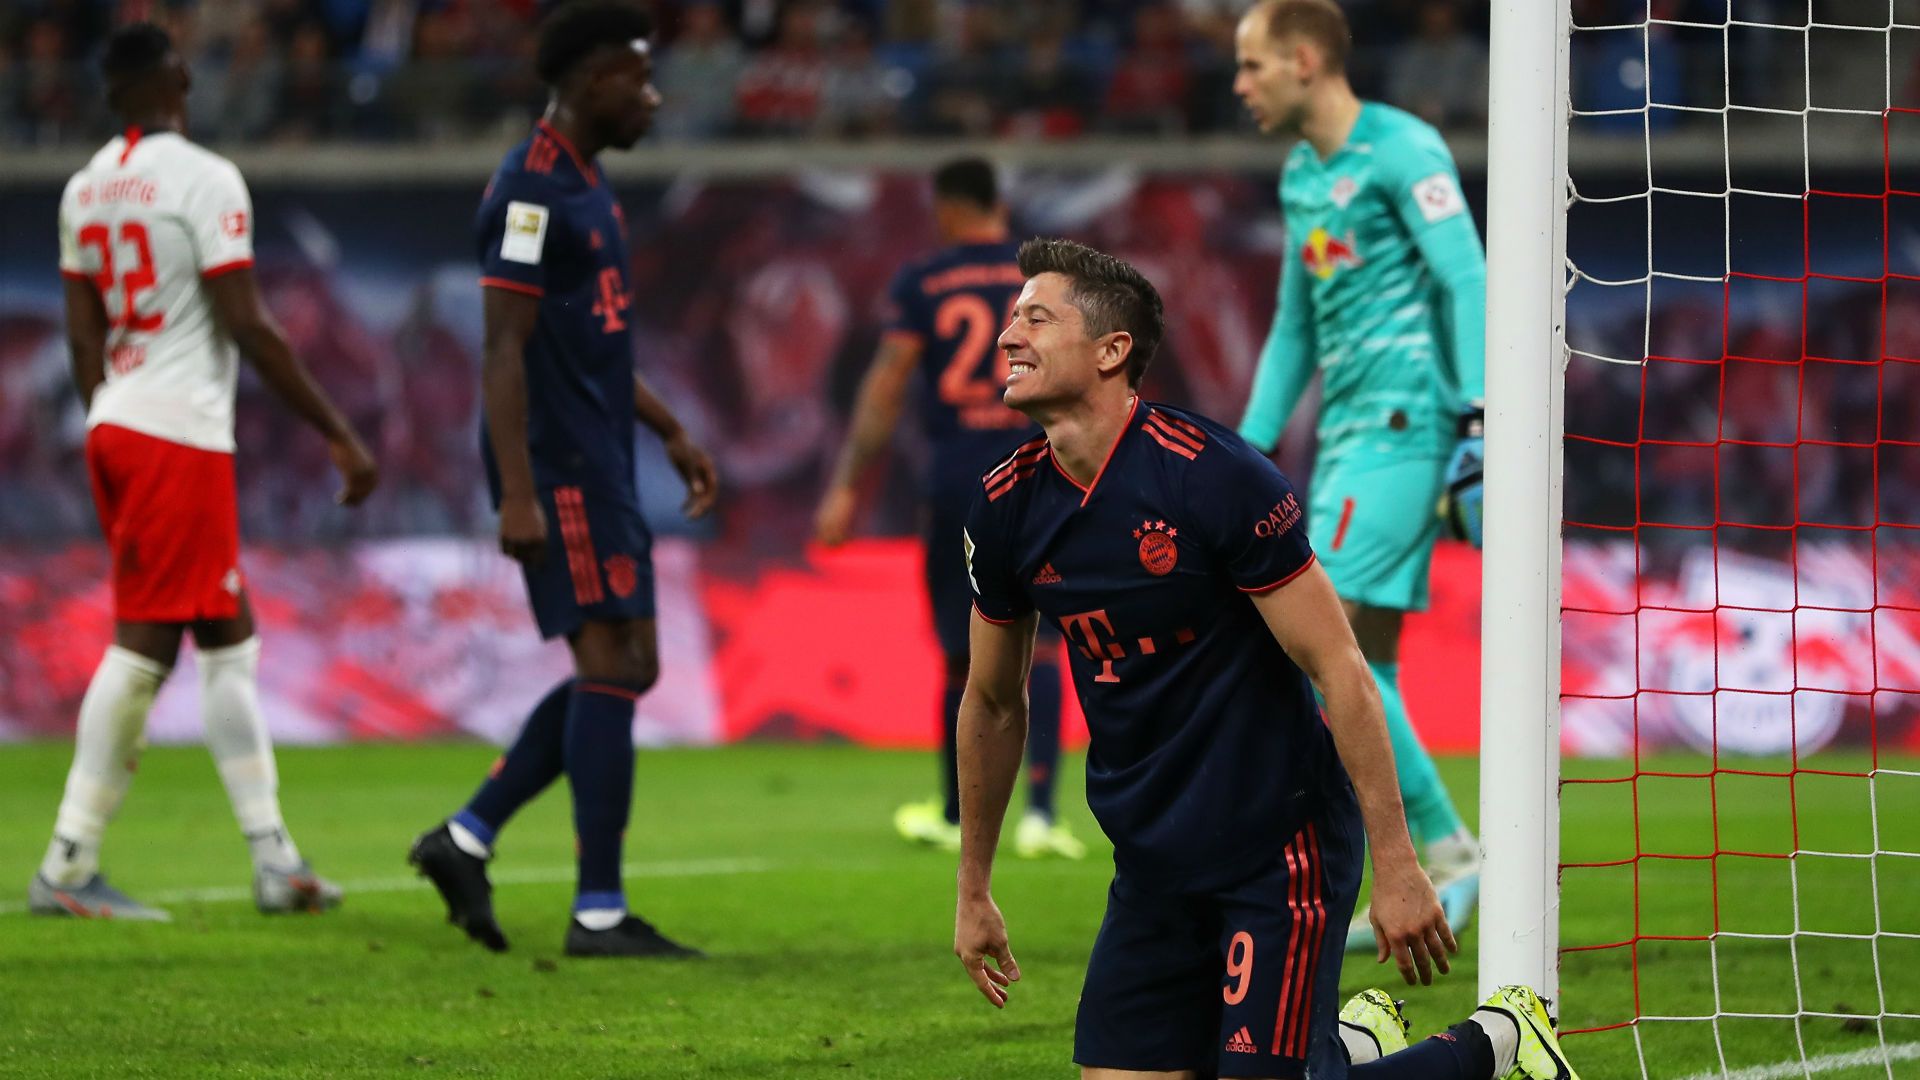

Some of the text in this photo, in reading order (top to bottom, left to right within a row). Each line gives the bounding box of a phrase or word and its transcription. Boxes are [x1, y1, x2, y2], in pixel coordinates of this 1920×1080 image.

[935, 292, 1012, 406] 2
[1255, 492, 1298, 538] QATAR
[1276, 506, 1302, 539] AIRWAYS
[1330, 497, 1356, 551] 1
[1032, 574, 1063, 585] adidas
[1223, 931, 1255, 1006] 9
[1225, 1042, 1257, 1054] adidas
